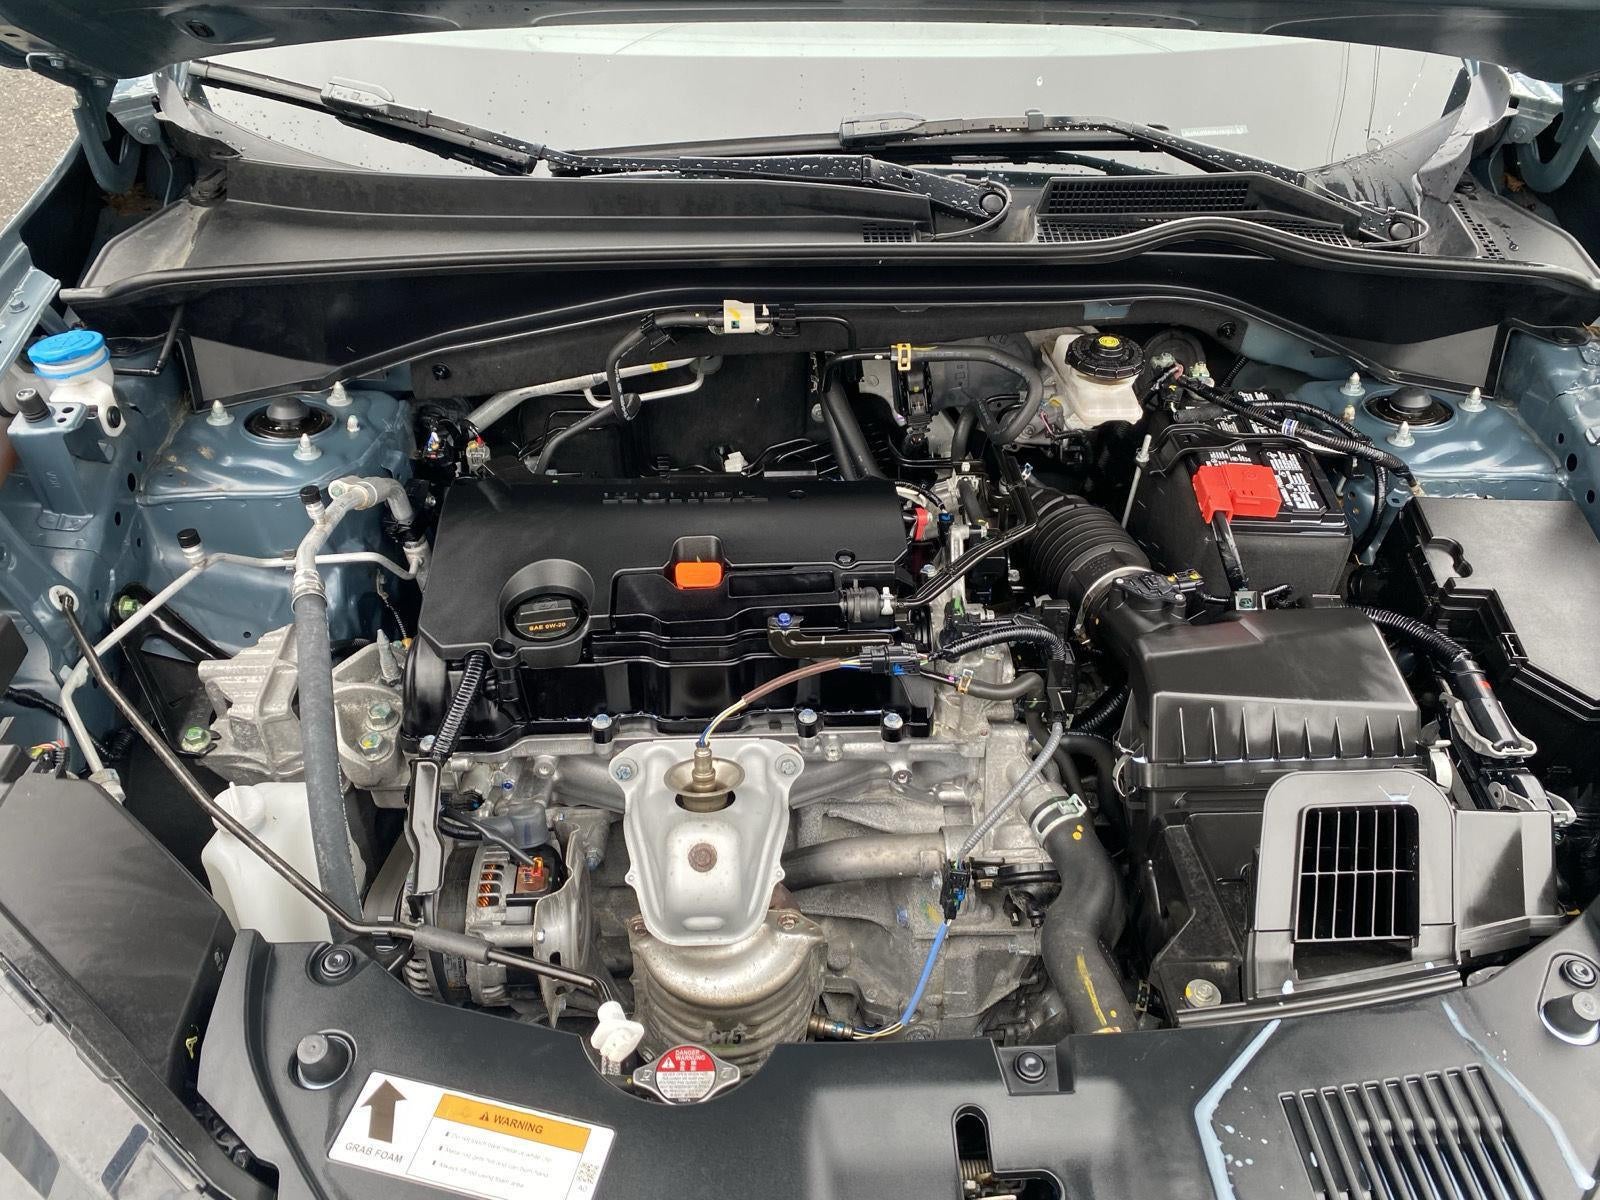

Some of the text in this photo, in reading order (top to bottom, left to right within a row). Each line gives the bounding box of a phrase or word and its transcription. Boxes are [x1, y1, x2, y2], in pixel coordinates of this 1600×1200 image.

[493, 1115, 544, 1135] WARNING
[345, 1142, 403, 1164] GRAB FOAM
